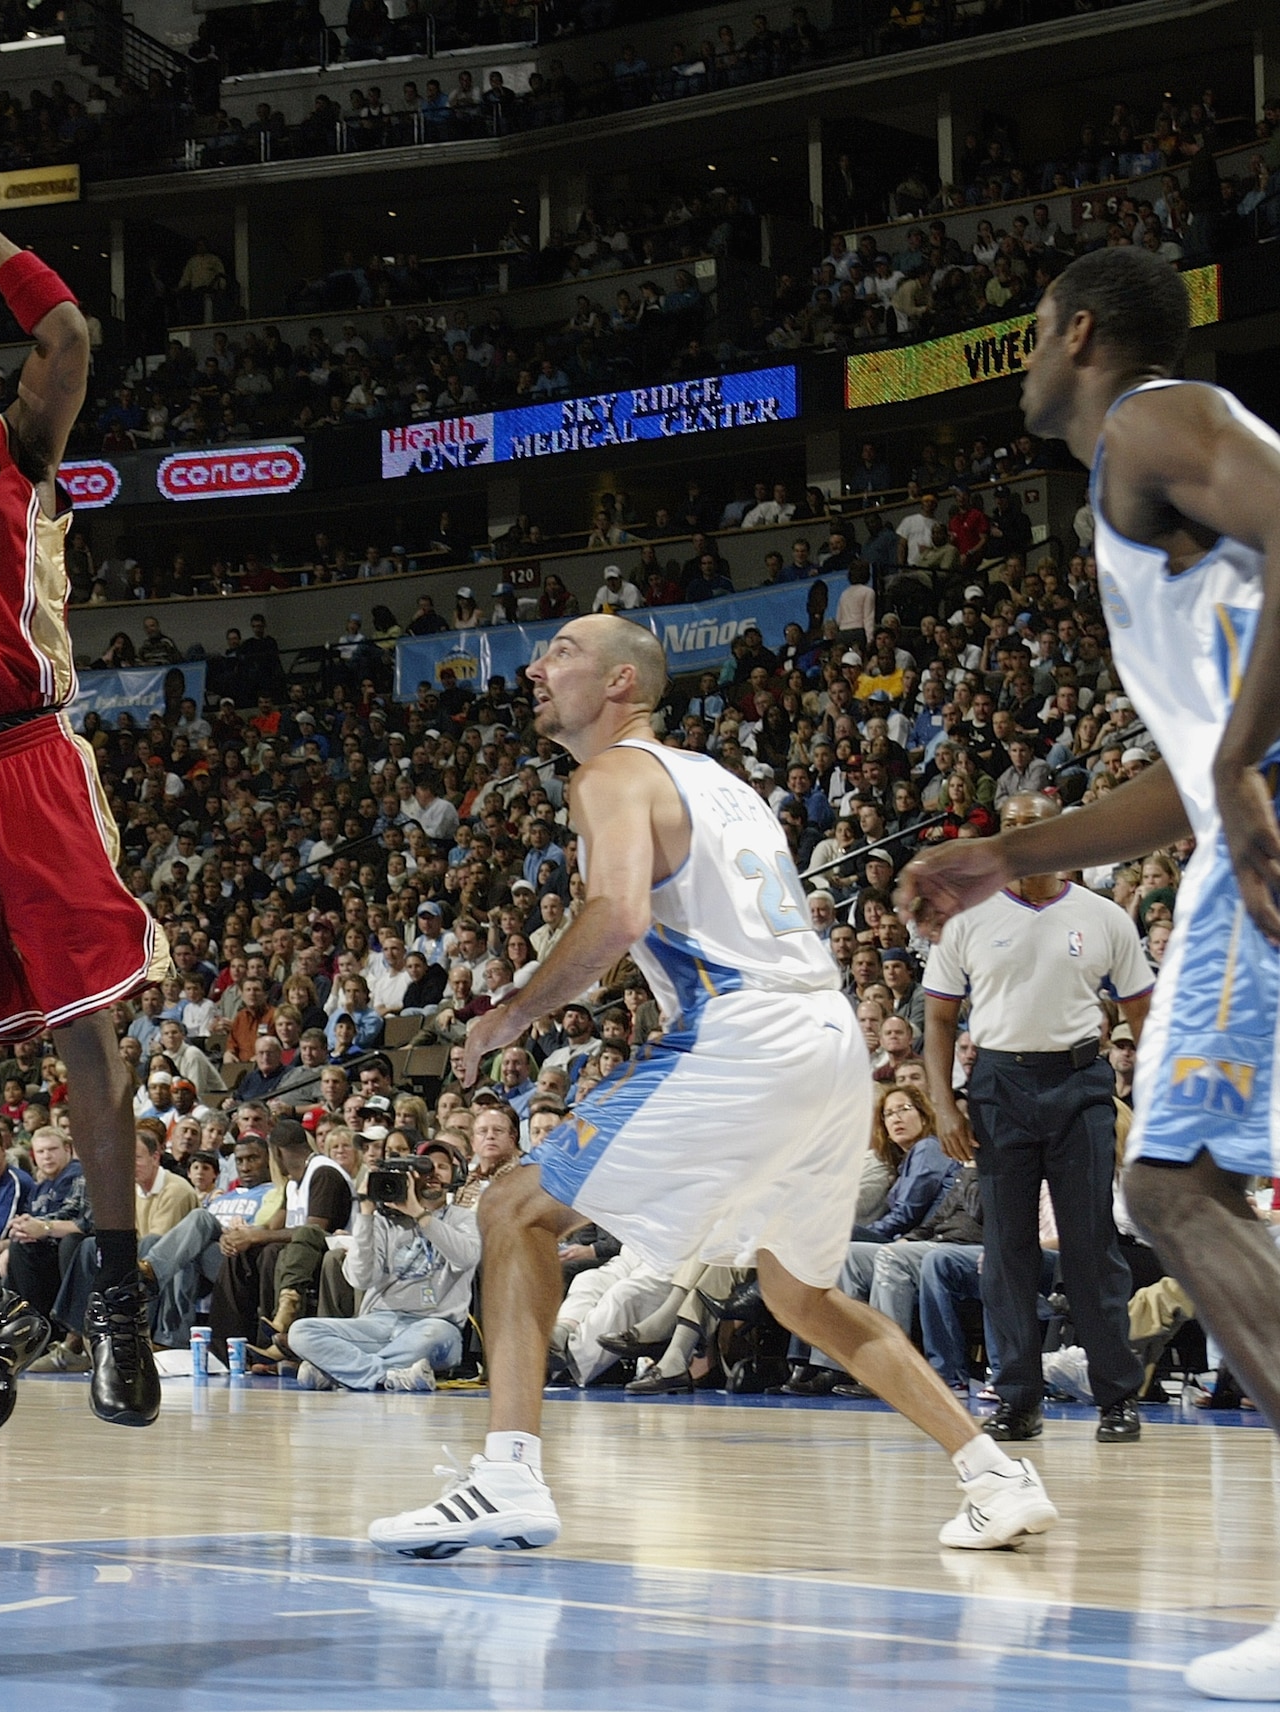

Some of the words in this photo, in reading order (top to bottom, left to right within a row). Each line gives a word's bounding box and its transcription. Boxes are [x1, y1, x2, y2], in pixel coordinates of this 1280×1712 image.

[1081, 196, 1118, 219] 26
[562, 392, 619, 426] SKY
[631, 377, 722, 416] RIDGE
[389, 416, 475, 453] Health
[511, 420, 638, 461] MEDICAL
[660, 396, 779, 437] CENTER
[510, 568, 534, 584] 120
